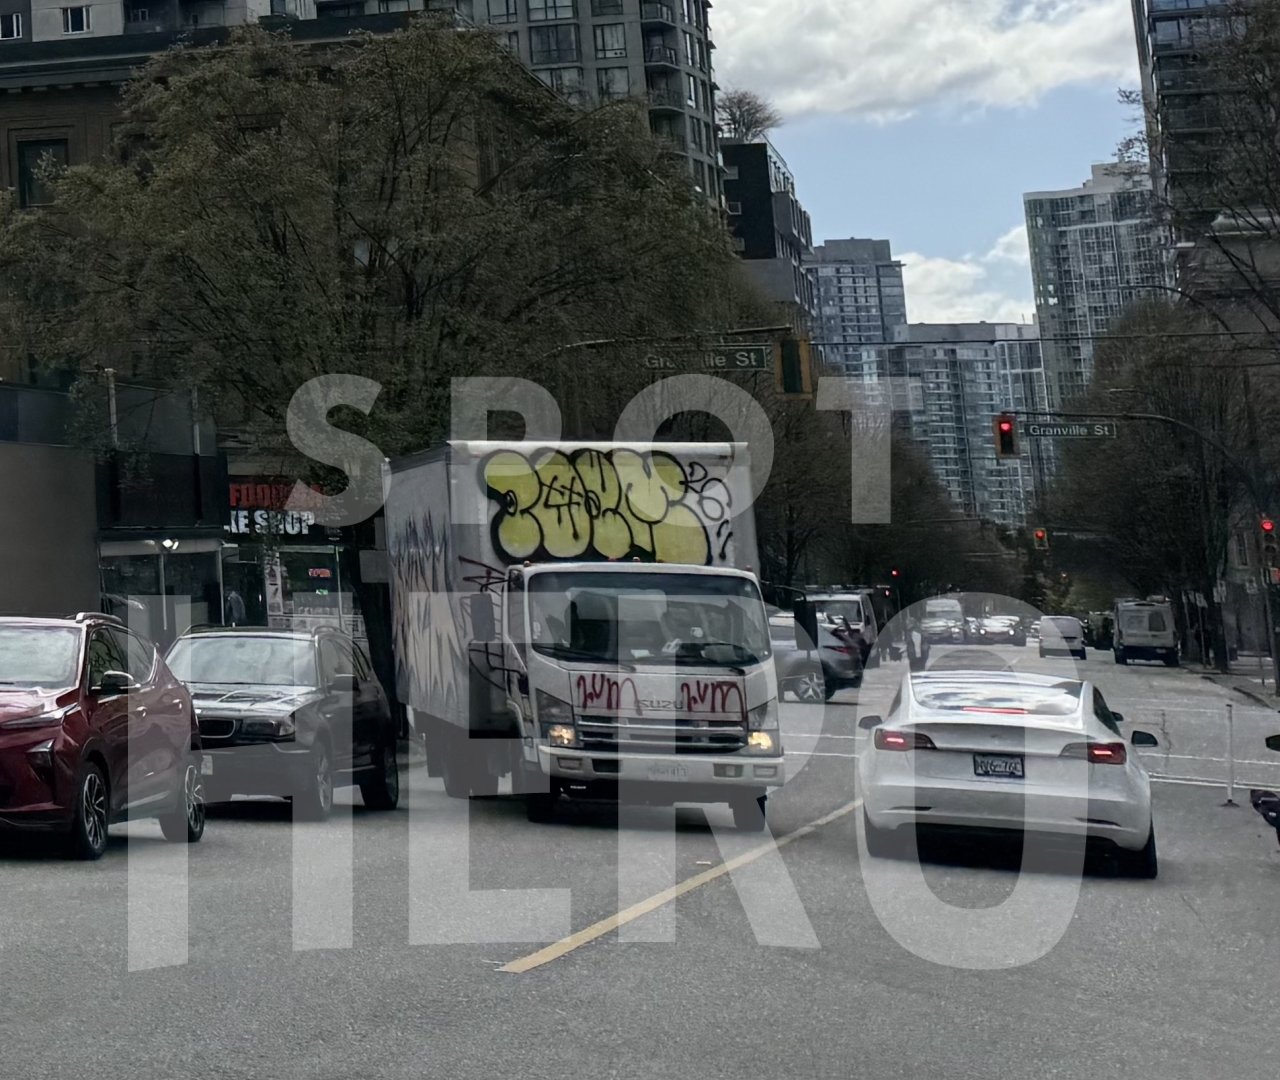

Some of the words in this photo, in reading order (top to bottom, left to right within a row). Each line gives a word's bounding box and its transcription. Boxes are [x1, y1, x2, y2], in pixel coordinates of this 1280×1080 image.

[645, 353, 726, 368] Gralle
[735, 351, 757, 366] St
[1029, 425, 1088, 436] Granville
[1094, 424, 1110, 436] St
[253, 510, 315, 535] SHOP
